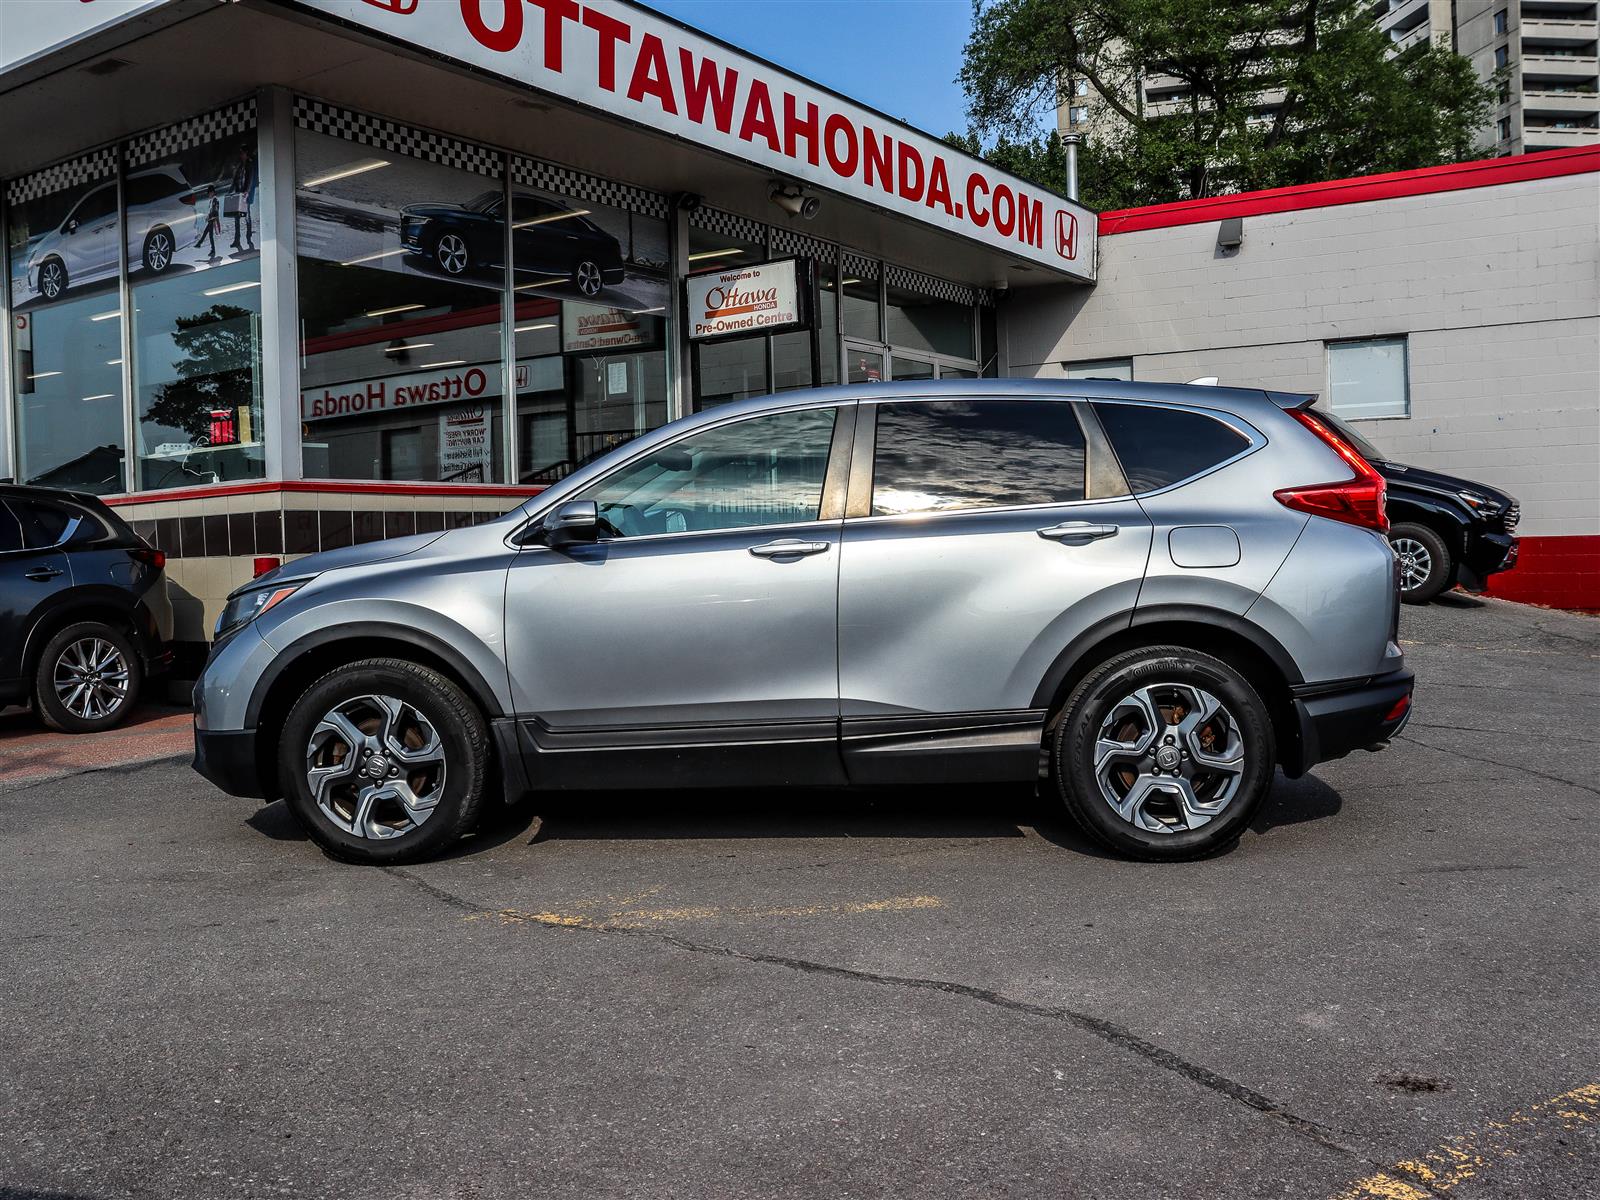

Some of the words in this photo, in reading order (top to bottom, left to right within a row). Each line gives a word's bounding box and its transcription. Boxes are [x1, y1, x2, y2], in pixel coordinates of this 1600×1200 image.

[460, 0, 1042, 249] OTTAWAHONDA.COM
[720, 272, 751, 283] Welcome
[753, 270, 761, 278] to
[706, 286, 777, 310] Ottawa
[753, 302, 776, 311] HONDA
[695, 316, 753, 334] Pre-Owned
[756, 312, 793, 325] Centre
